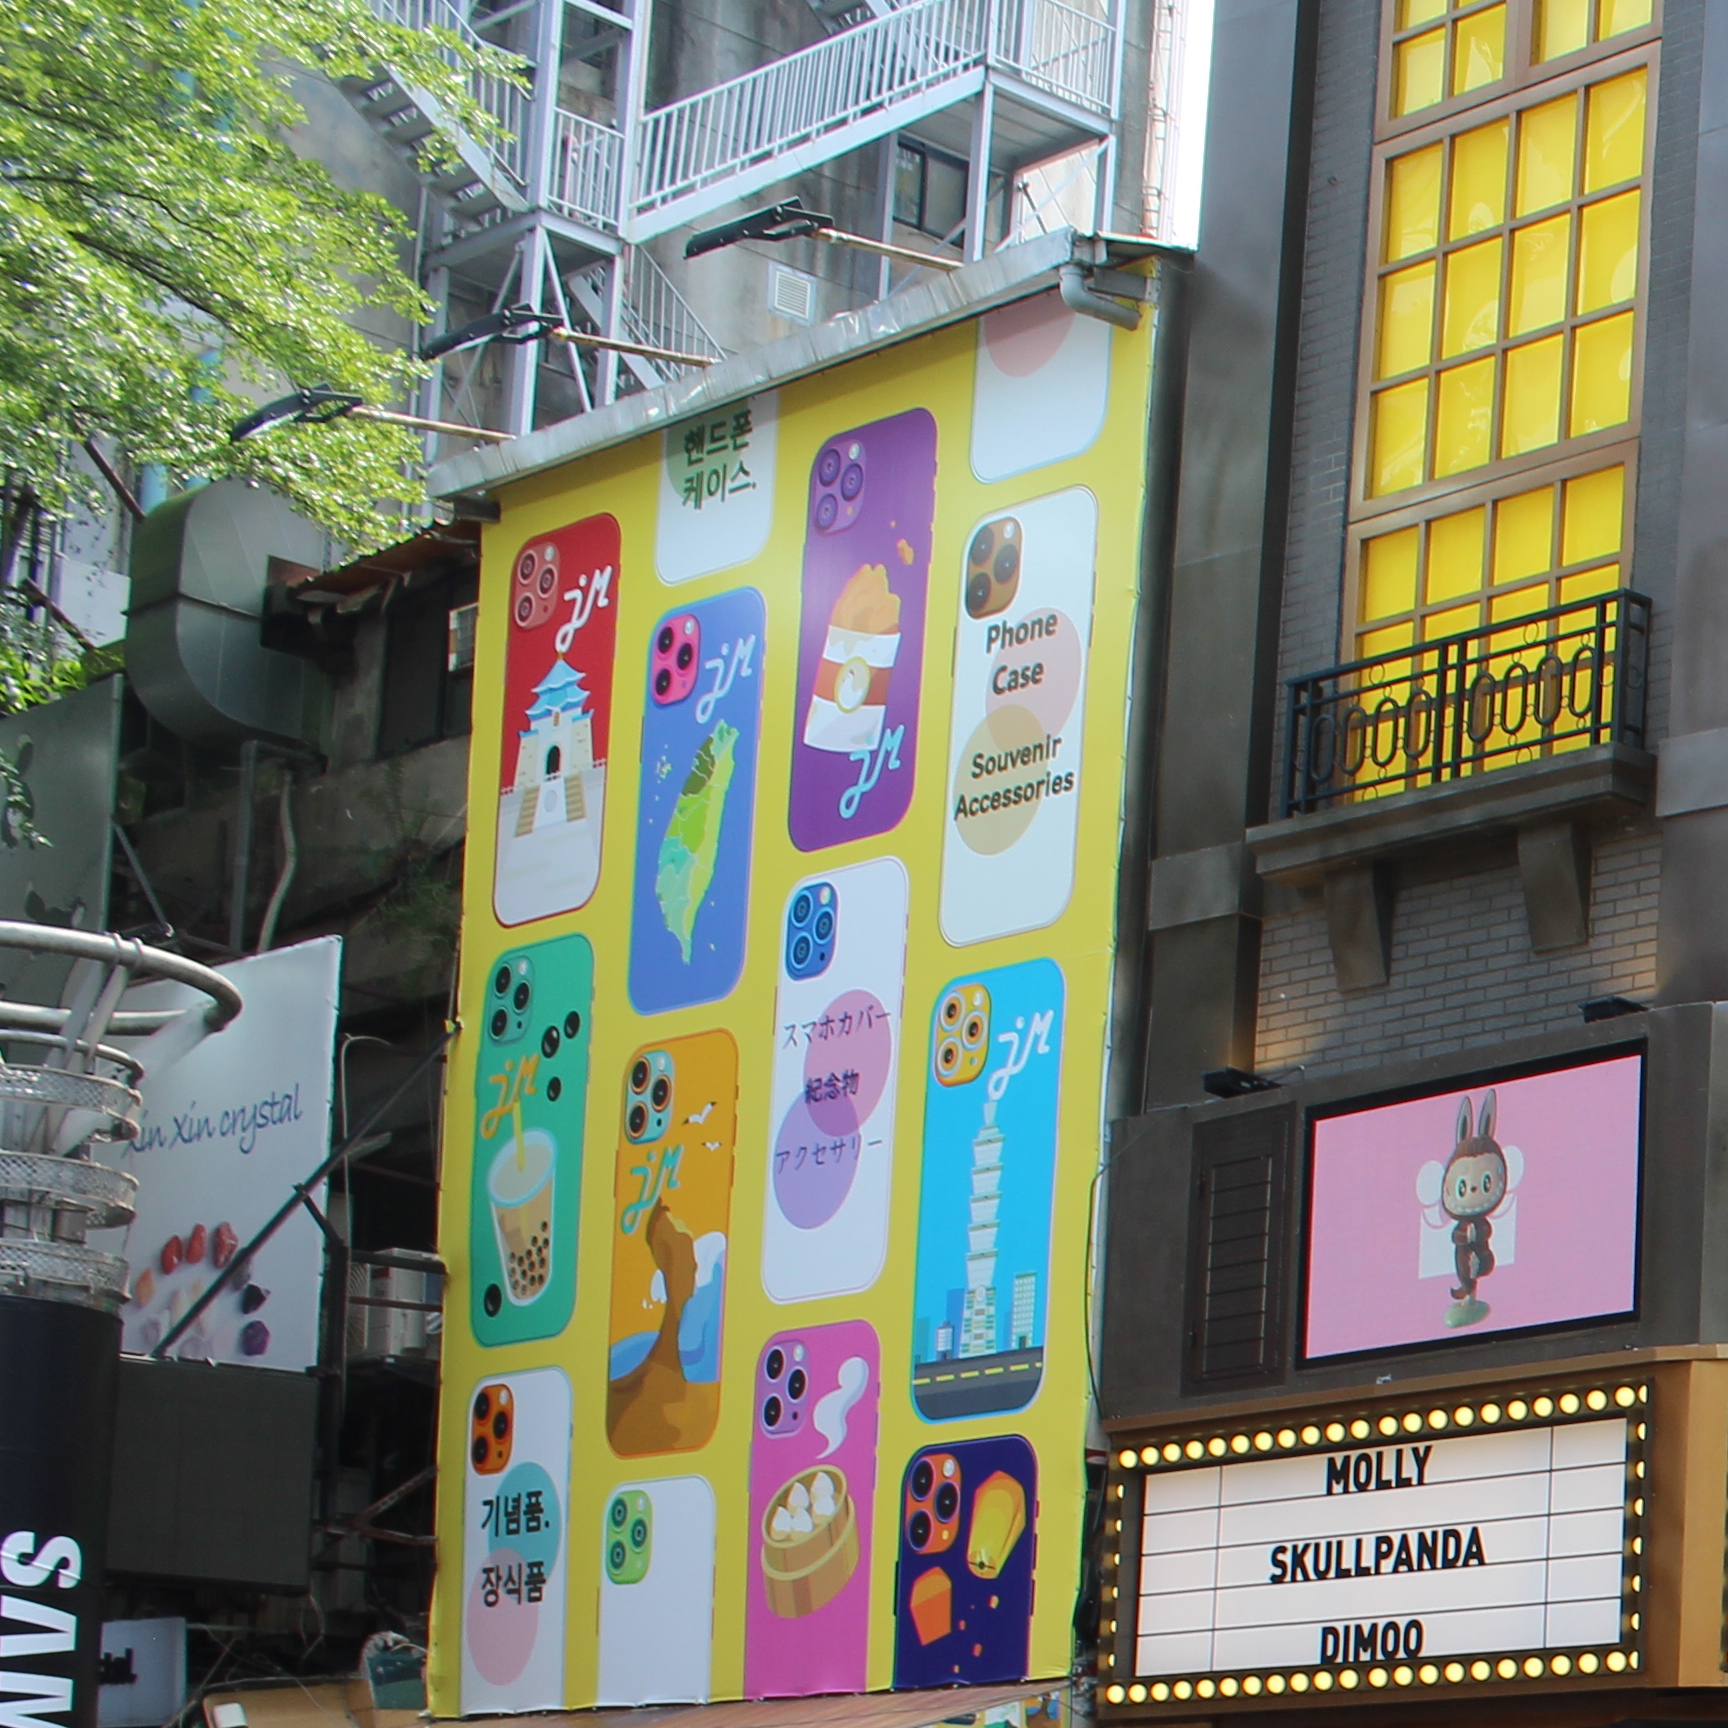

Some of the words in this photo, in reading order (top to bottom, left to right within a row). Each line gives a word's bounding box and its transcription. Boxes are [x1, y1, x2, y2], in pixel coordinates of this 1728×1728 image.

[683, 407, 754, 467] 핸드폰
[984, 613, 1059, 654] Phone
[991, 658, 1045, 696] Case
[970, 734, 1063, 781] Souvenir
[953, 770, 1076, 823] Accessories
[782, 1005, 893, 1050] スマホカバー
[219, 1082, 304, 1155] crystal
[774, 1135, 884, 1174] アクセサリー
[1325, 1444, 1434, 1497] MOLLY
[1268, 1525, 1487, 1585] SKULLPANDA
[481, 1561, 548, 1607] 장식품
[1319, 1619, 1425, 1665] DIMOO
